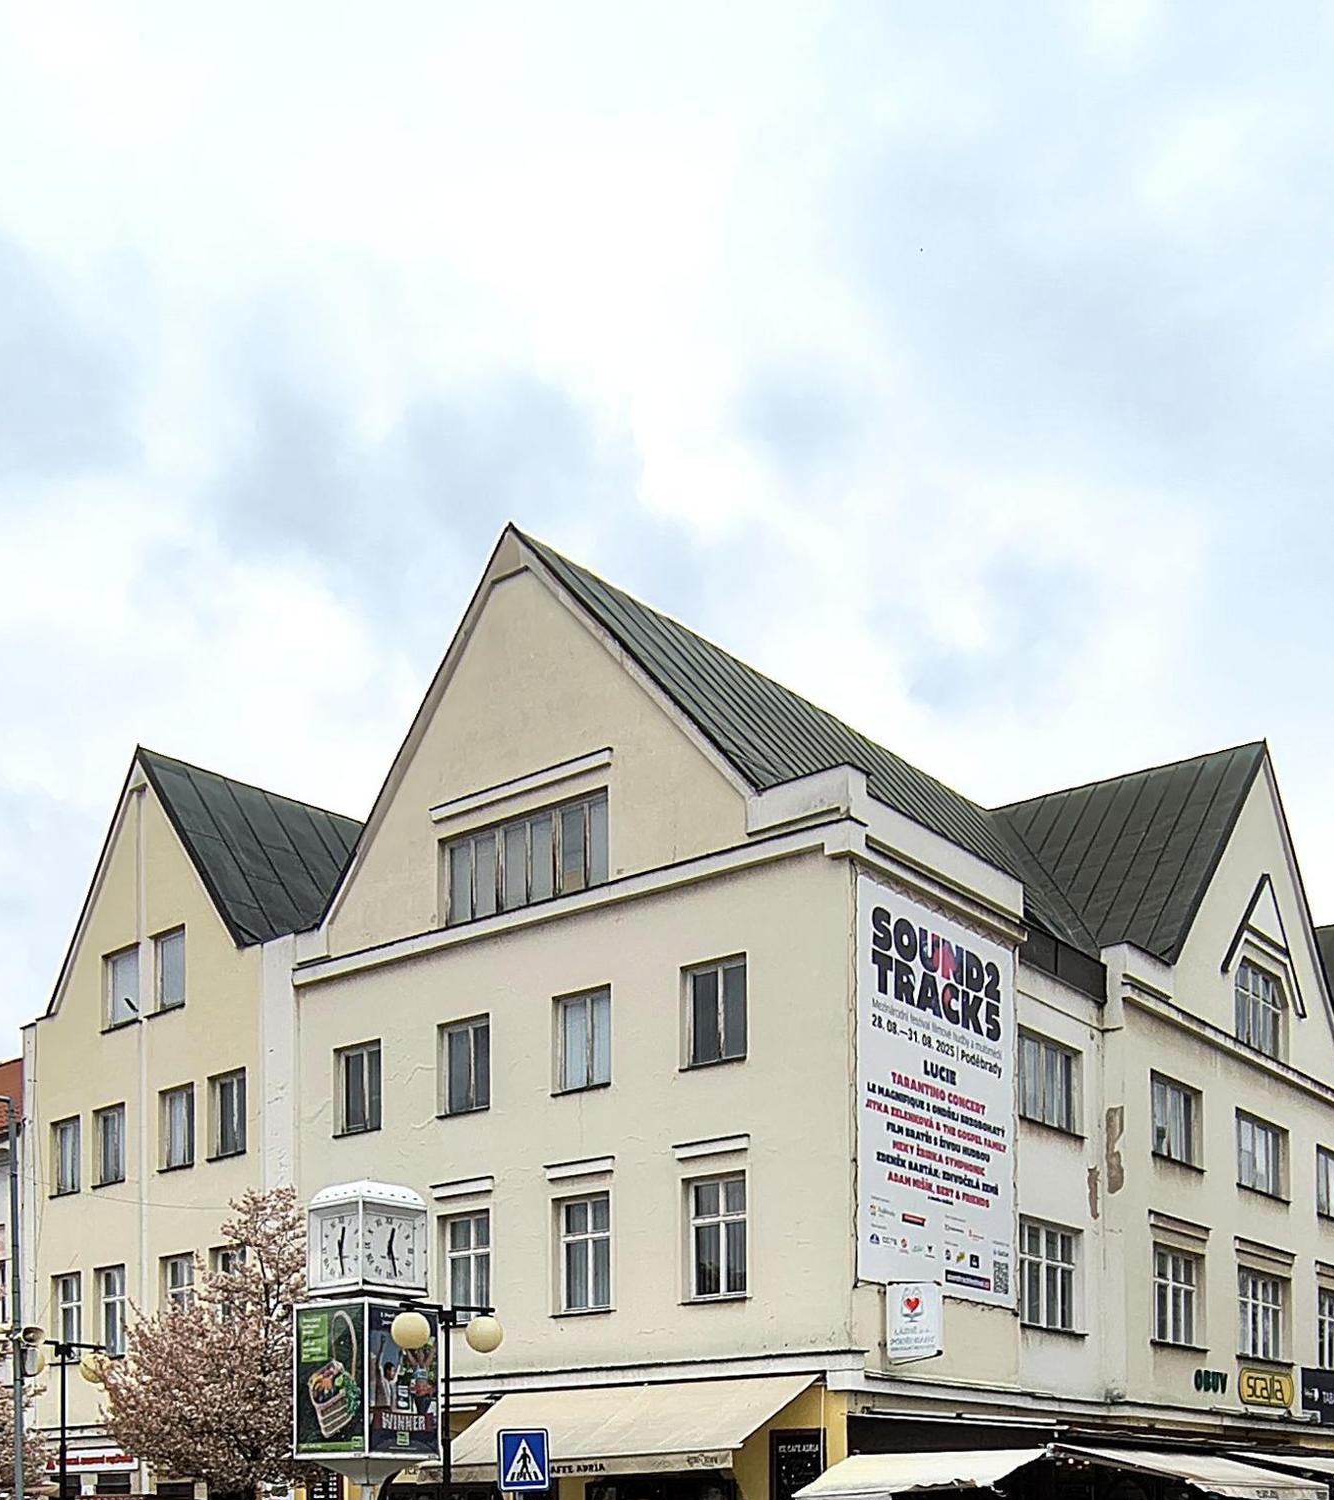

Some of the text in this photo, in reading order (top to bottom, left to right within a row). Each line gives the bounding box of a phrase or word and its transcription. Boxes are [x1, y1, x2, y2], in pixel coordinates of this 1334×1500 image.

[872, 906, 1001, 1003] SOUND2
[872, 948, 1002, 1042] TRACK5
[872, 1013, 885, 1030] 28.
[921, 1034, 934, 1050] 08.
[936, 1040, 955, 1058] 2025
[961, 1049, 1002, 1079] Poděbrady
[923, 1060, 956, 1086] LUCIE
[867, 1081, 877, 1094] LE
[877, 1084, 925, 1111] MAGNIFIQUE
[891, 1071, 987, 1116] TARANTINO CONCERT
[865, 1098, 889, 1115] JITKA
[942, 1124, 956, 1137] THE
[957, 1129, 983, 1146] GOSPEL
[983, 1136, 1007, 1153] FAMILY
[886, 1121, 904, 1136] FILM
[887, 1171, 911, 1187] ADAM
[962, 1191, 990, 1209] FRIENDS
[1194, 1368, 1228, 1394] OBUV
[382, 1411, 426, 1431] WINNER
[550, 1464, 575, 1474] AFFE
[577, 1462, 606, 1473] ADRIA
